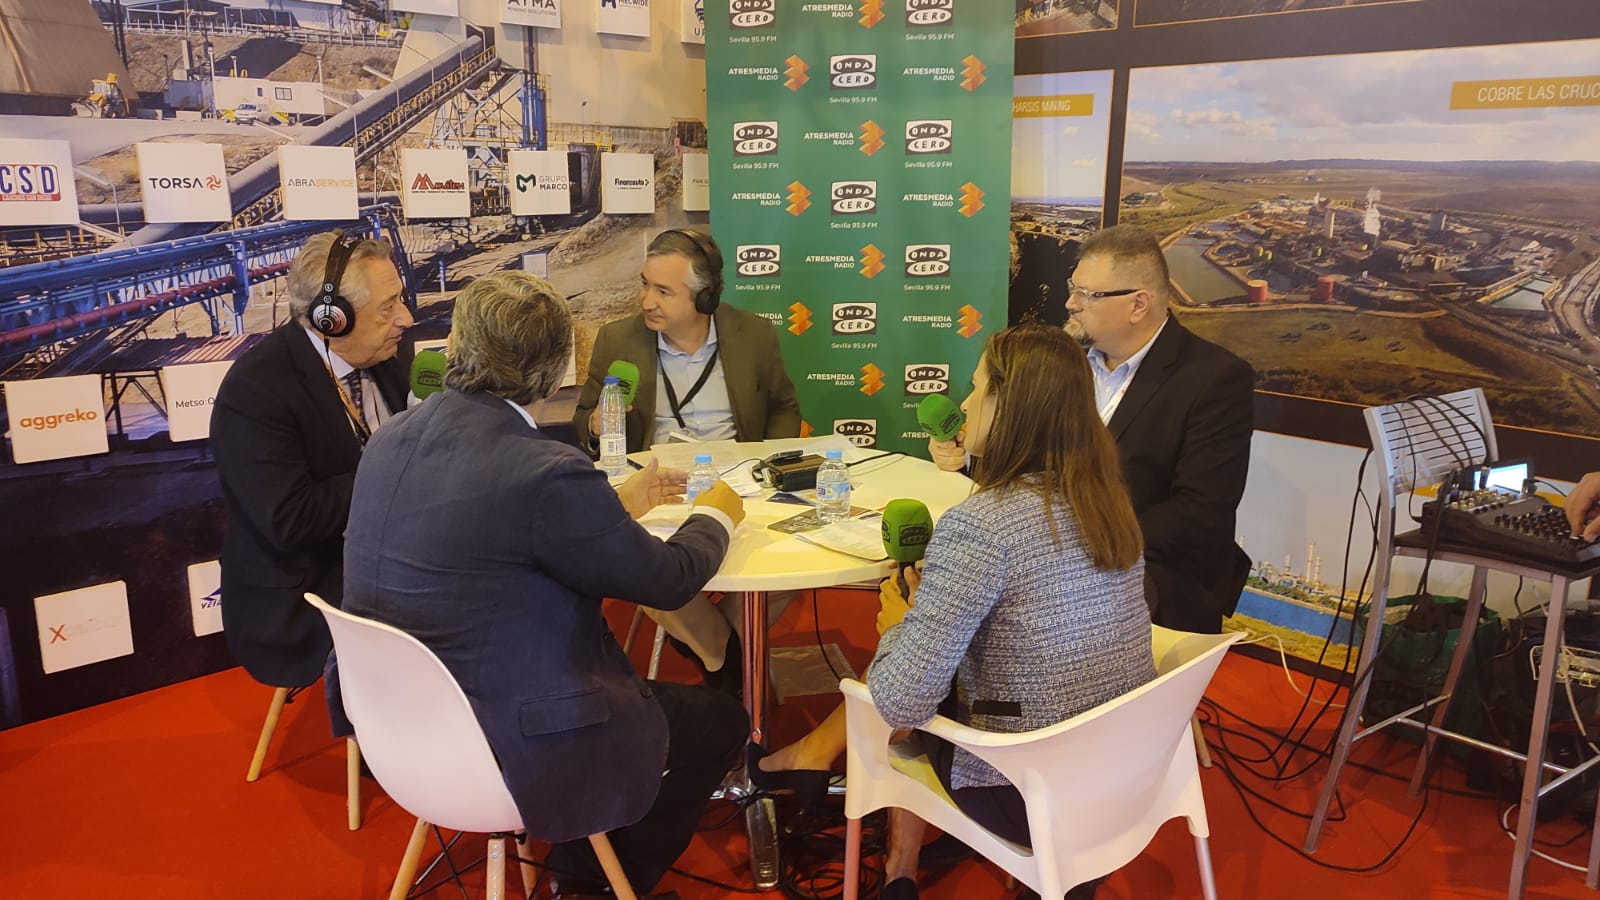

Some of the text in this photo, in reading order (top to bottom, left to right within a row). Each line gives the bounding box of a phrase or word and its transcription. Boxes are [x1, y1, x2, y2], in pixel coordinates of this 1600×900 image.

[735, 0, 769, 9] ONDA
[802, 4, 853, 12] ATRESMEDIA
[738, 15, 769, 23] CERO
[914, 12, 946, 21] CERO
[837, 62, 870, 70] ONDA
[728, 67, 779, 75] ATRESMEDIA
[903, 67, 955, 75] ATRESMEDIA
[838, 75, 868, 84] CERO
[1478, 86, 1524, 102] COBRE
[1528, 84, 1556, 100] LAS
[1041, 99, 1070, 112] MINING
[739, 128, 772, 137] ONDA
[911, 126, 945, 136] ONDA
[804, 132, 854, 140] ATRESMEDIA
[741, 142, 771, 150] CERO
[914, 140, 944, 149] CERO
[0, 165, 55, 193] CSD
[148, 177, 203, 189] TORSA
[837, 187, 870, 196] ONDA
[732, 192, 781, 200] ATRESMEDIA
[903, 193, 953, 201] ATRESMEDIA
[839, 201, 870, 210] CERO
[742, 251, 775, 259] ONDA
[805, 255, 855, 263] ATRESMEDIA
[744, 264, 774, 272] CERO
[913, 264, 943, 272] CERO
[837, 309, 870, 317] ONDA
[902, 315, 952, 323] ATRESMEDIA
[840, 321, 870, 330] CERO
[807, 373, 855, 381] ATRESMEDIA
[910, 369, 944, 378] ONDA
[912, 383, 942, 391] CERO
[20, 408, 97, 430] aggreko
[838, 425, 871, 433] ONDA
[850, 436, 870, 445] ERO
